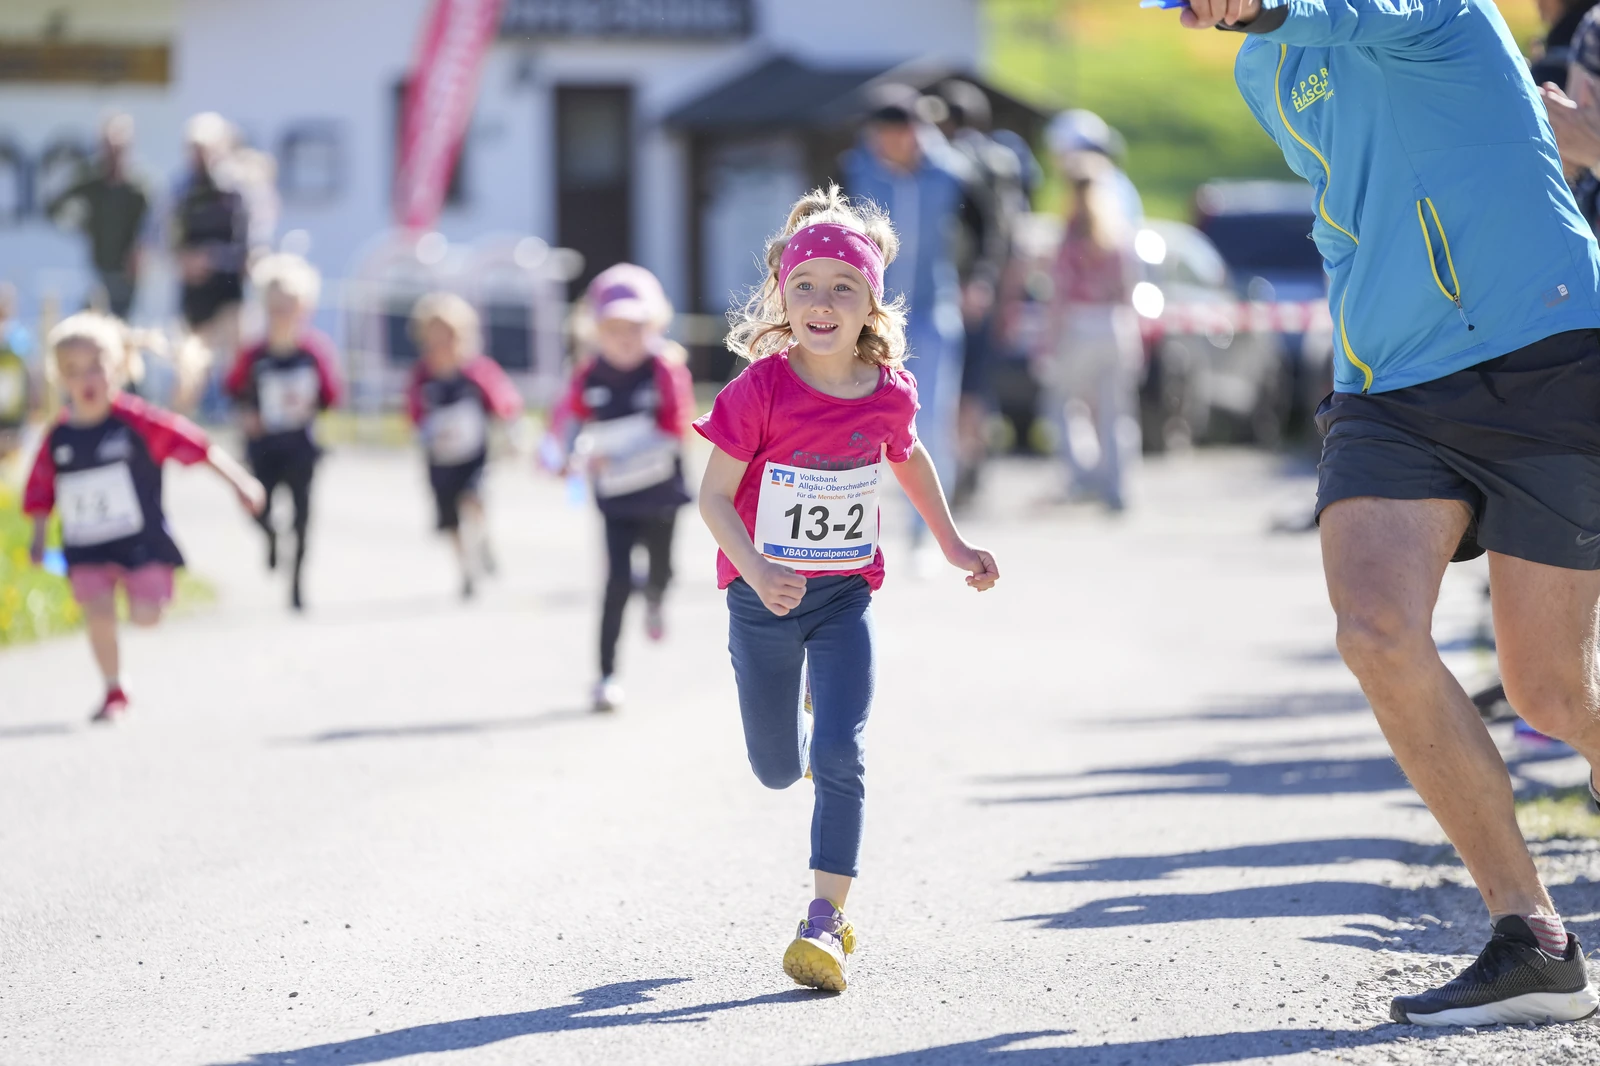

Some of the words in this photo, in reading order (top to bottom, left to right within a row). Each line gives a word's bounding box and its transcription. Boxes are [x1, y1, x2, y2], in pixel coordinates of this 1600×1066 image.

[1291, 67, 1329, 99] SPOR
[1293, 78, 1329, 110] HASCH
[798, 481, 869, 492] Allgäu-Oberschwaben
[799, 473, 838, 483] Volksbank
[784, 503, 864, 541] 13-2
[782, 547, 808, 557] VBAO
[809, 549, 859, 559] Voralpencup
